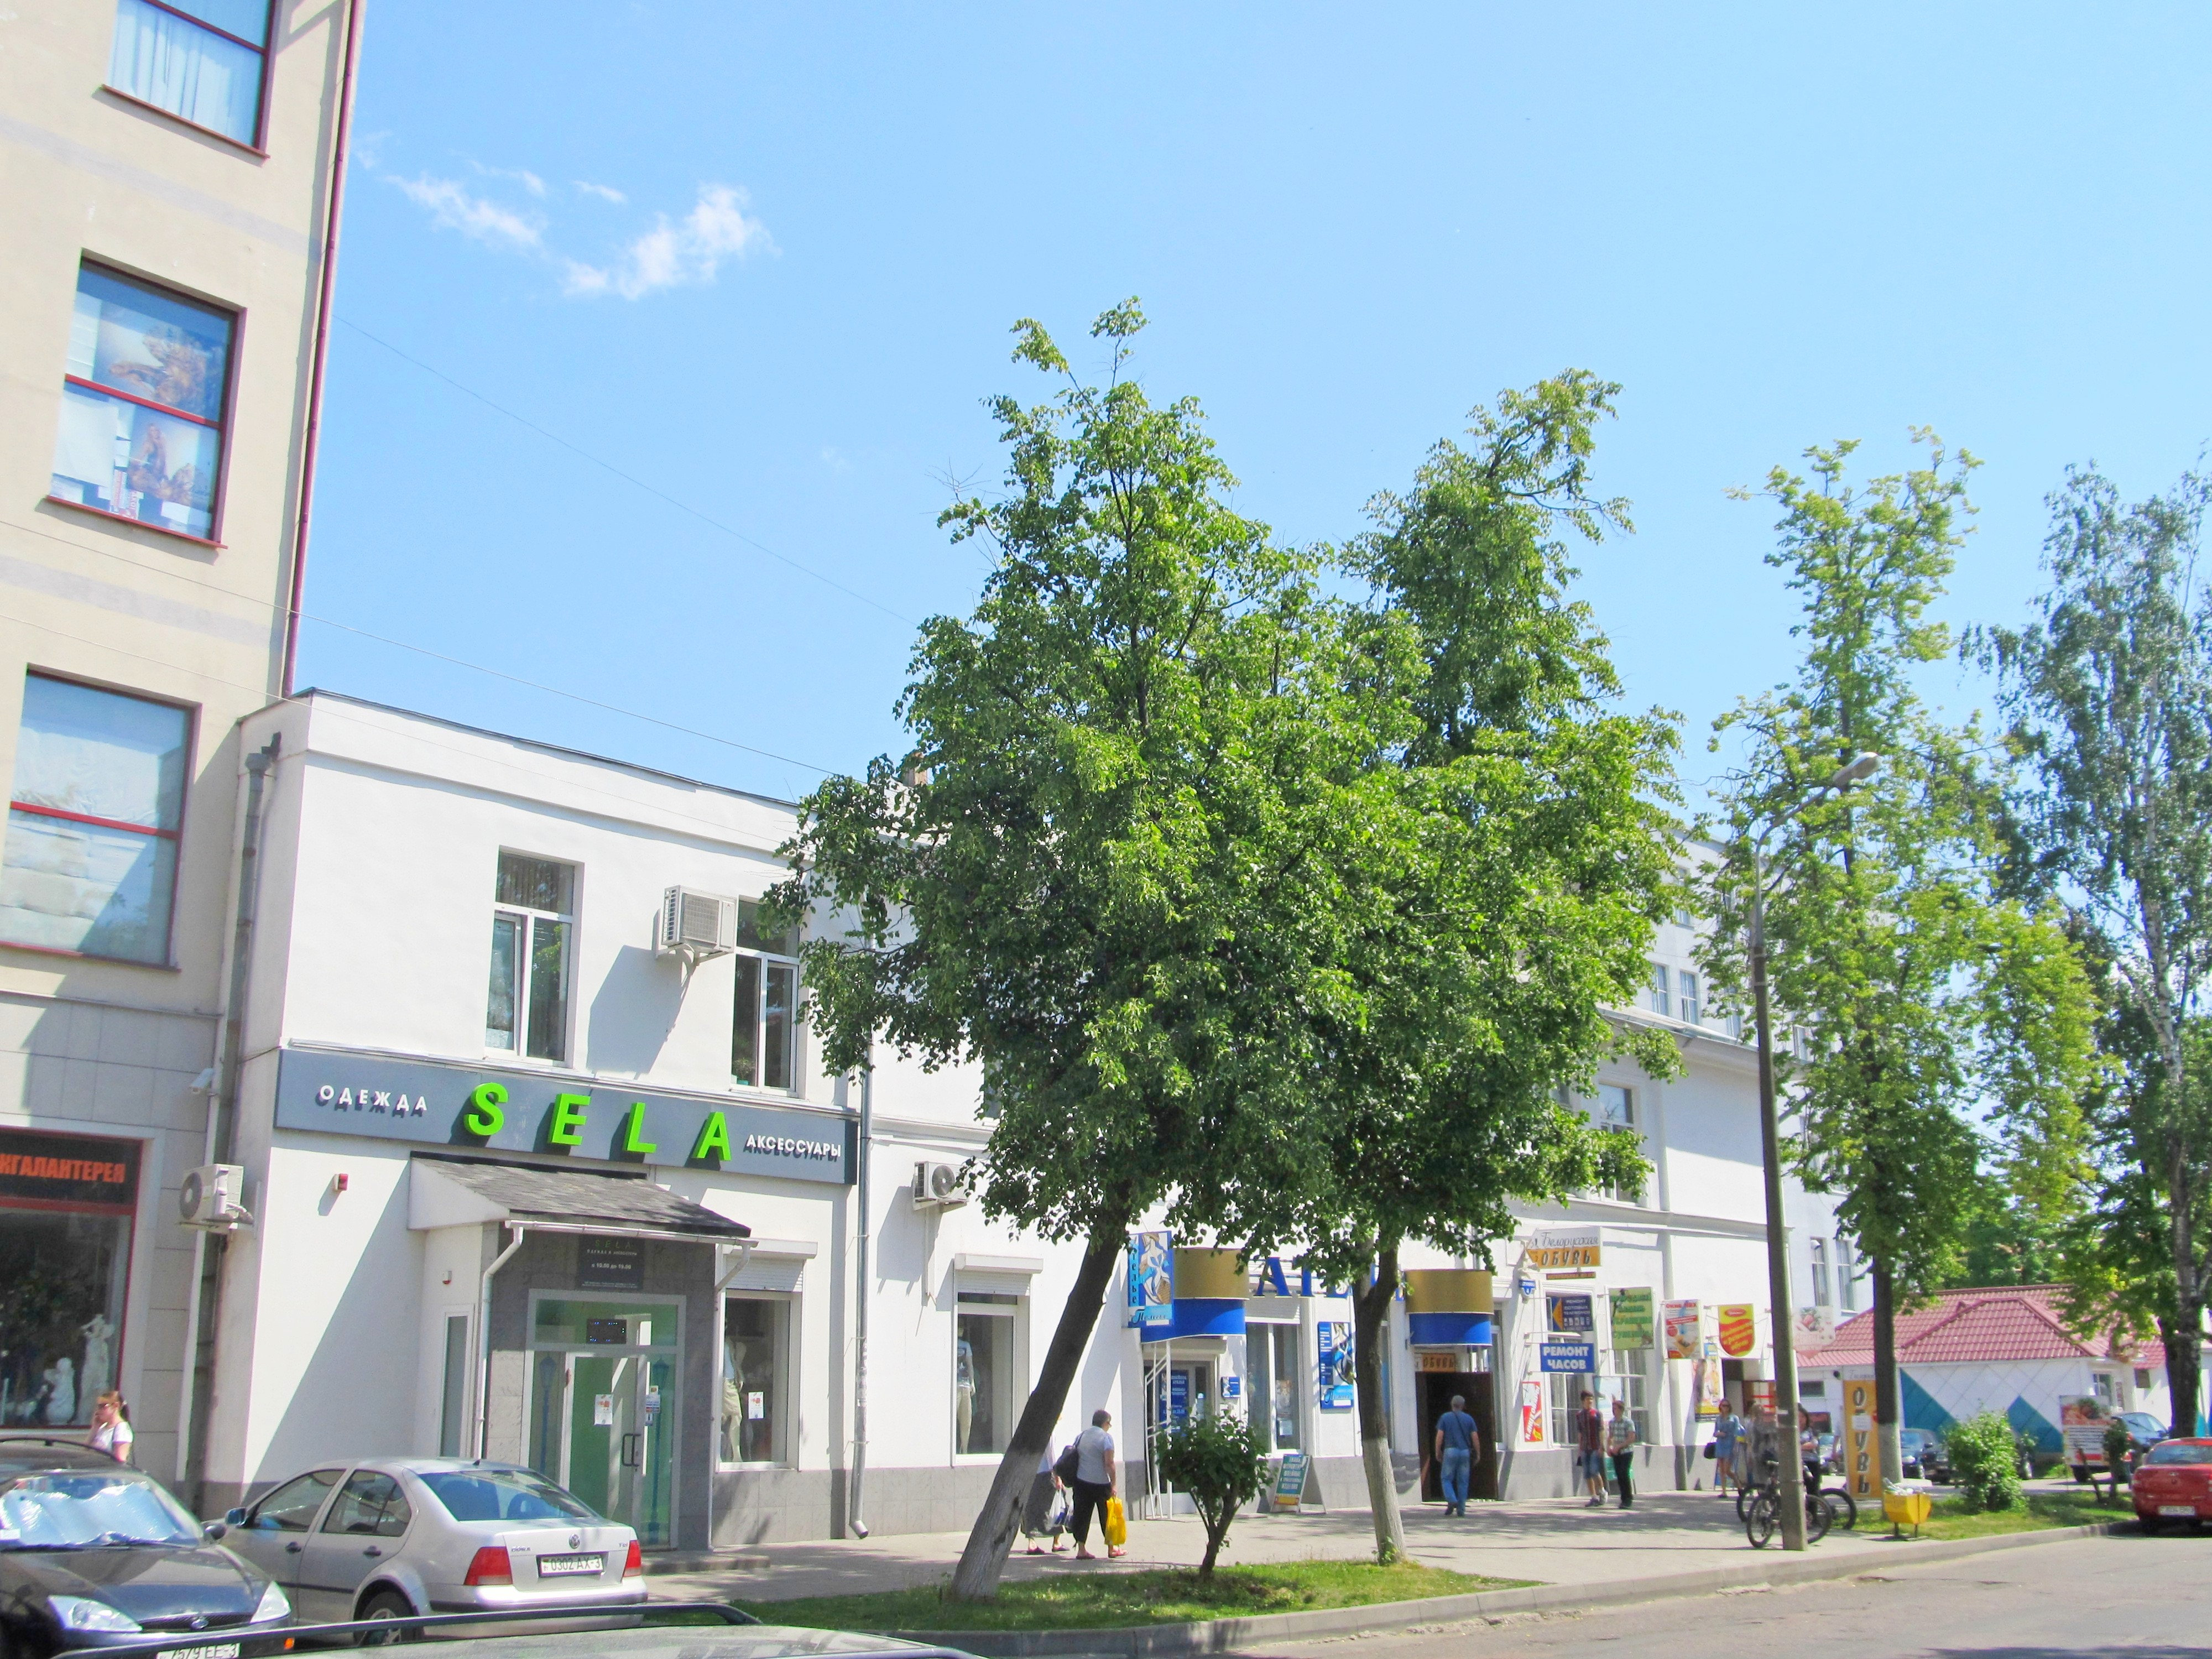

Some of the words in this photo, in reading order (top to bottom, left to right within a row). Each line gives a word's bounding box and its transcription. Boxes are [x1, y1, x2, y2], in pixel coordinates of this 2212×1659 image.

[320, 1084, 427, 1112] ОДЕЖДА
[463, 1082, 733, 1161] SELA
[745, 1134, 842, 1159] АКСЕССУАРЫ
[595, 1239, 631, 1249] SELA
[1541, 1250, 1592, 1266] ОБУВЬ
[1543, 1345, 1590, 1357] РЕМОНТ
[1547, 1359, 1587, 1370] ЧАСОВ
[551, 1556, 575, 1571] 0302
